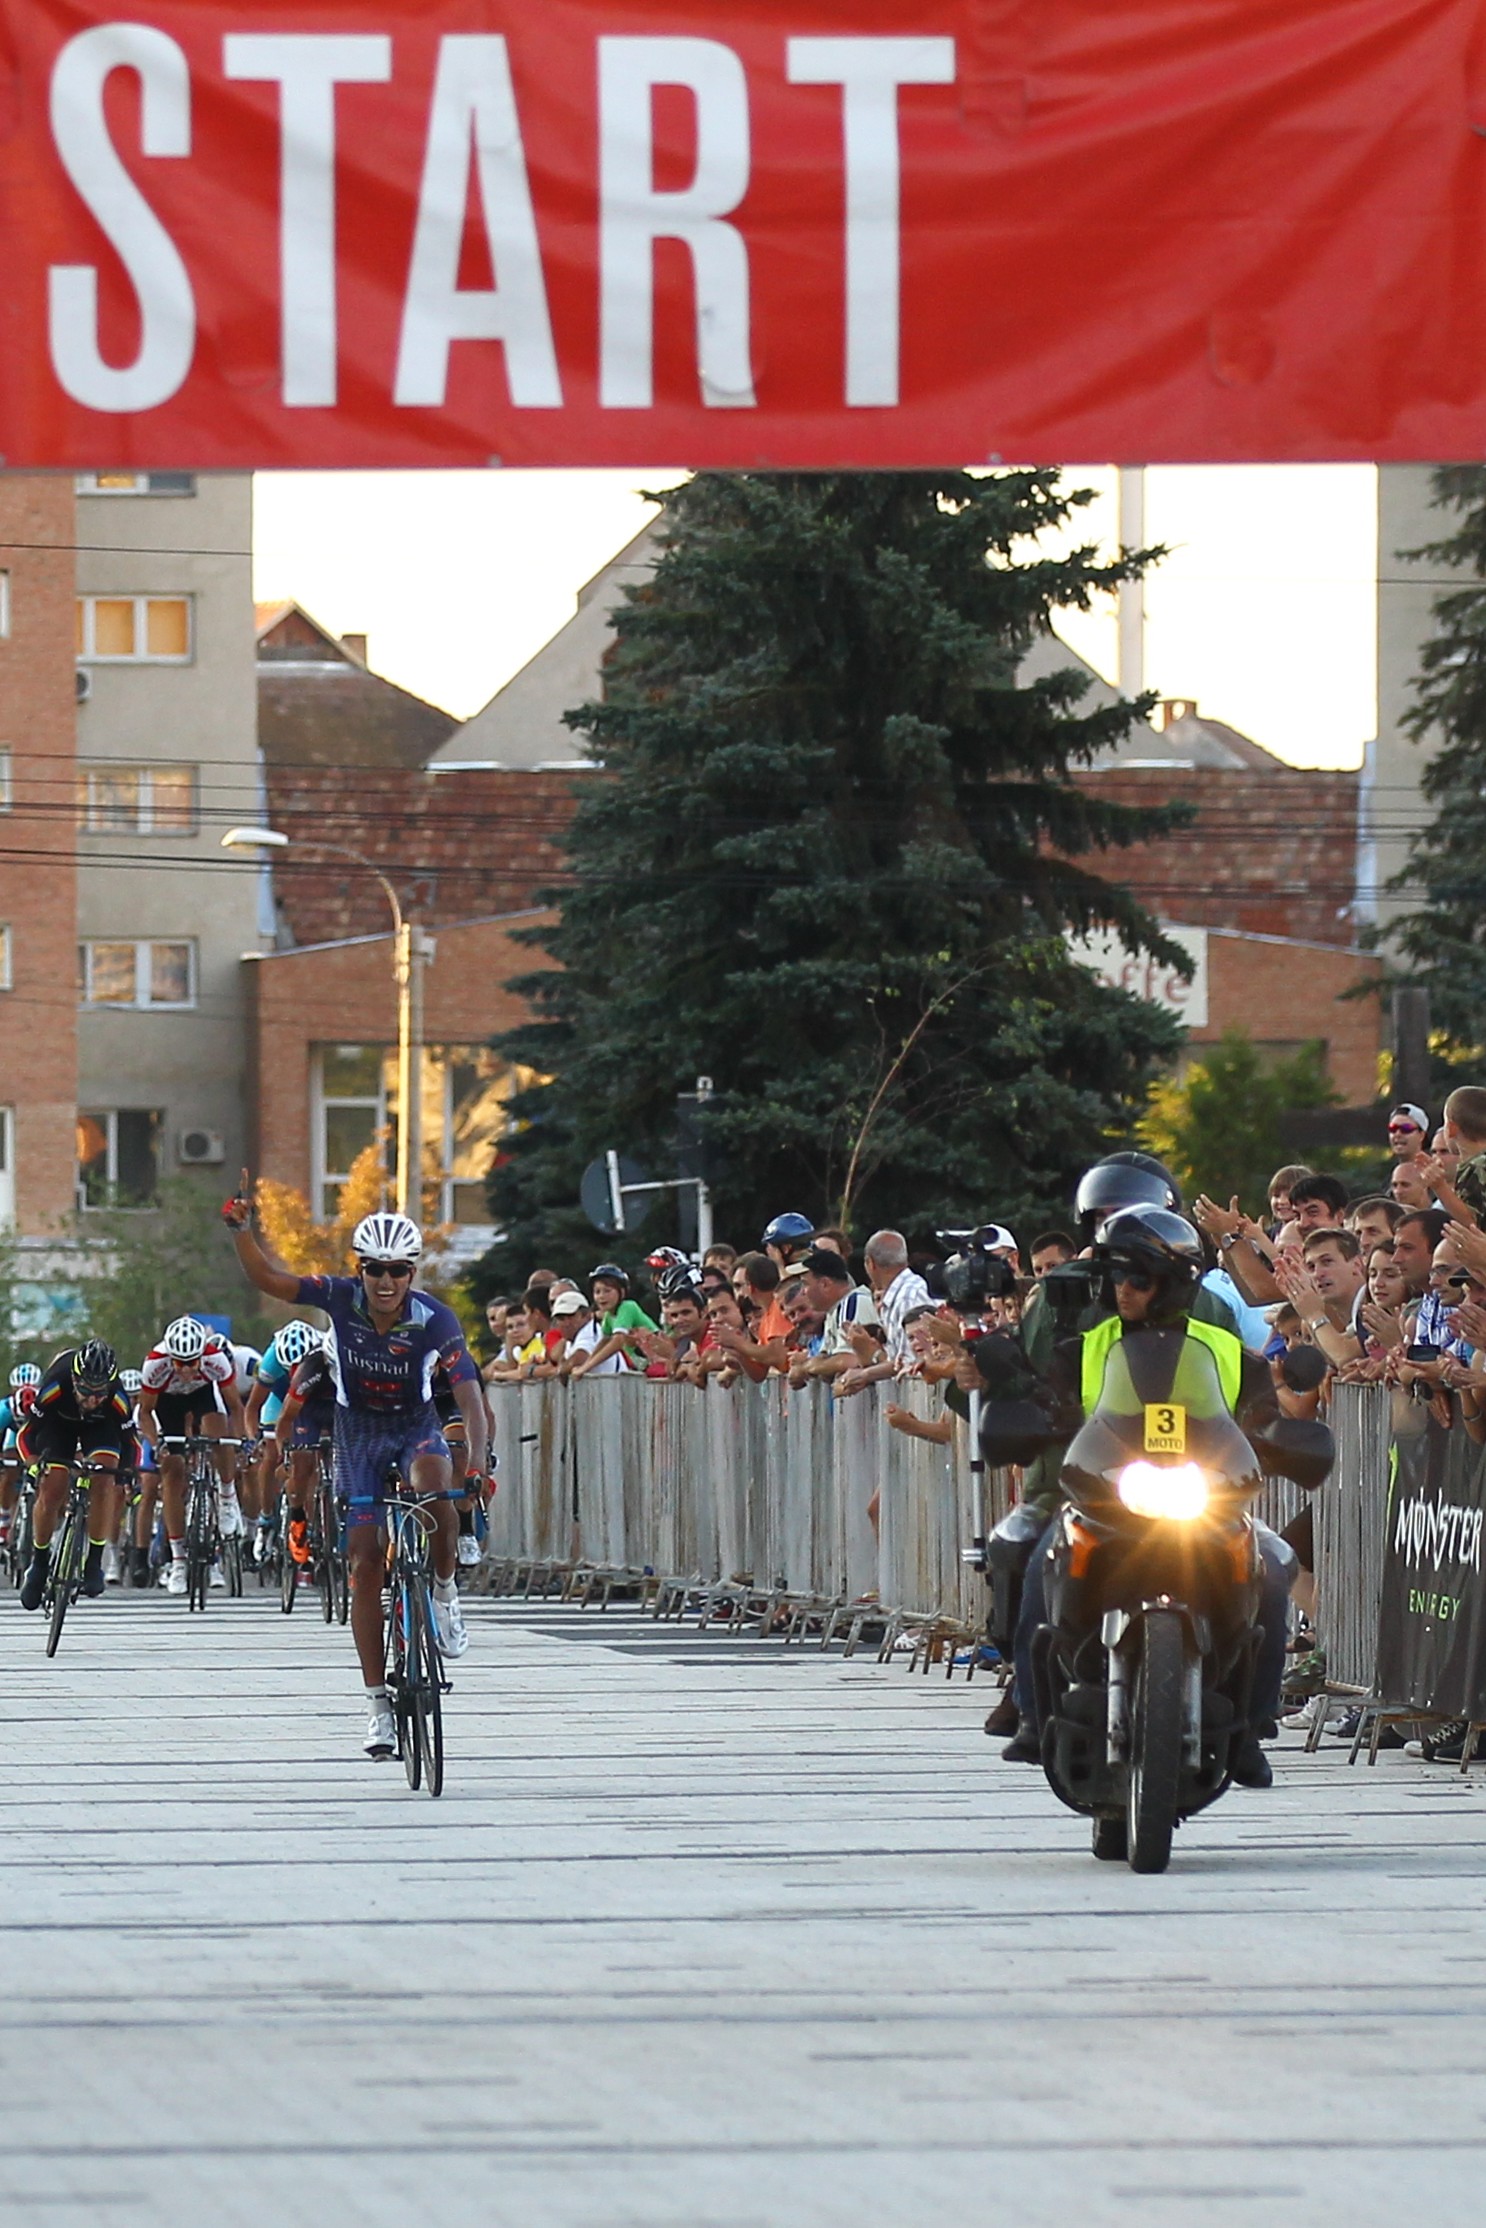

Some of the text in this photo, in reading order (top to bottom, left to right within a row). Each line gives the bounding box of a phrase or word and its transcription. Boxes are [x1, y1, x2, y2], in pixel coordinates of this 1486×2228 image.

[47, 21, 956, 413] START
[1147, 1438, 1183, 1450] MOTO
[1157, 1408, 1175, 1434] 3
[1394, 1486, 1484, 1576] MONSTER
